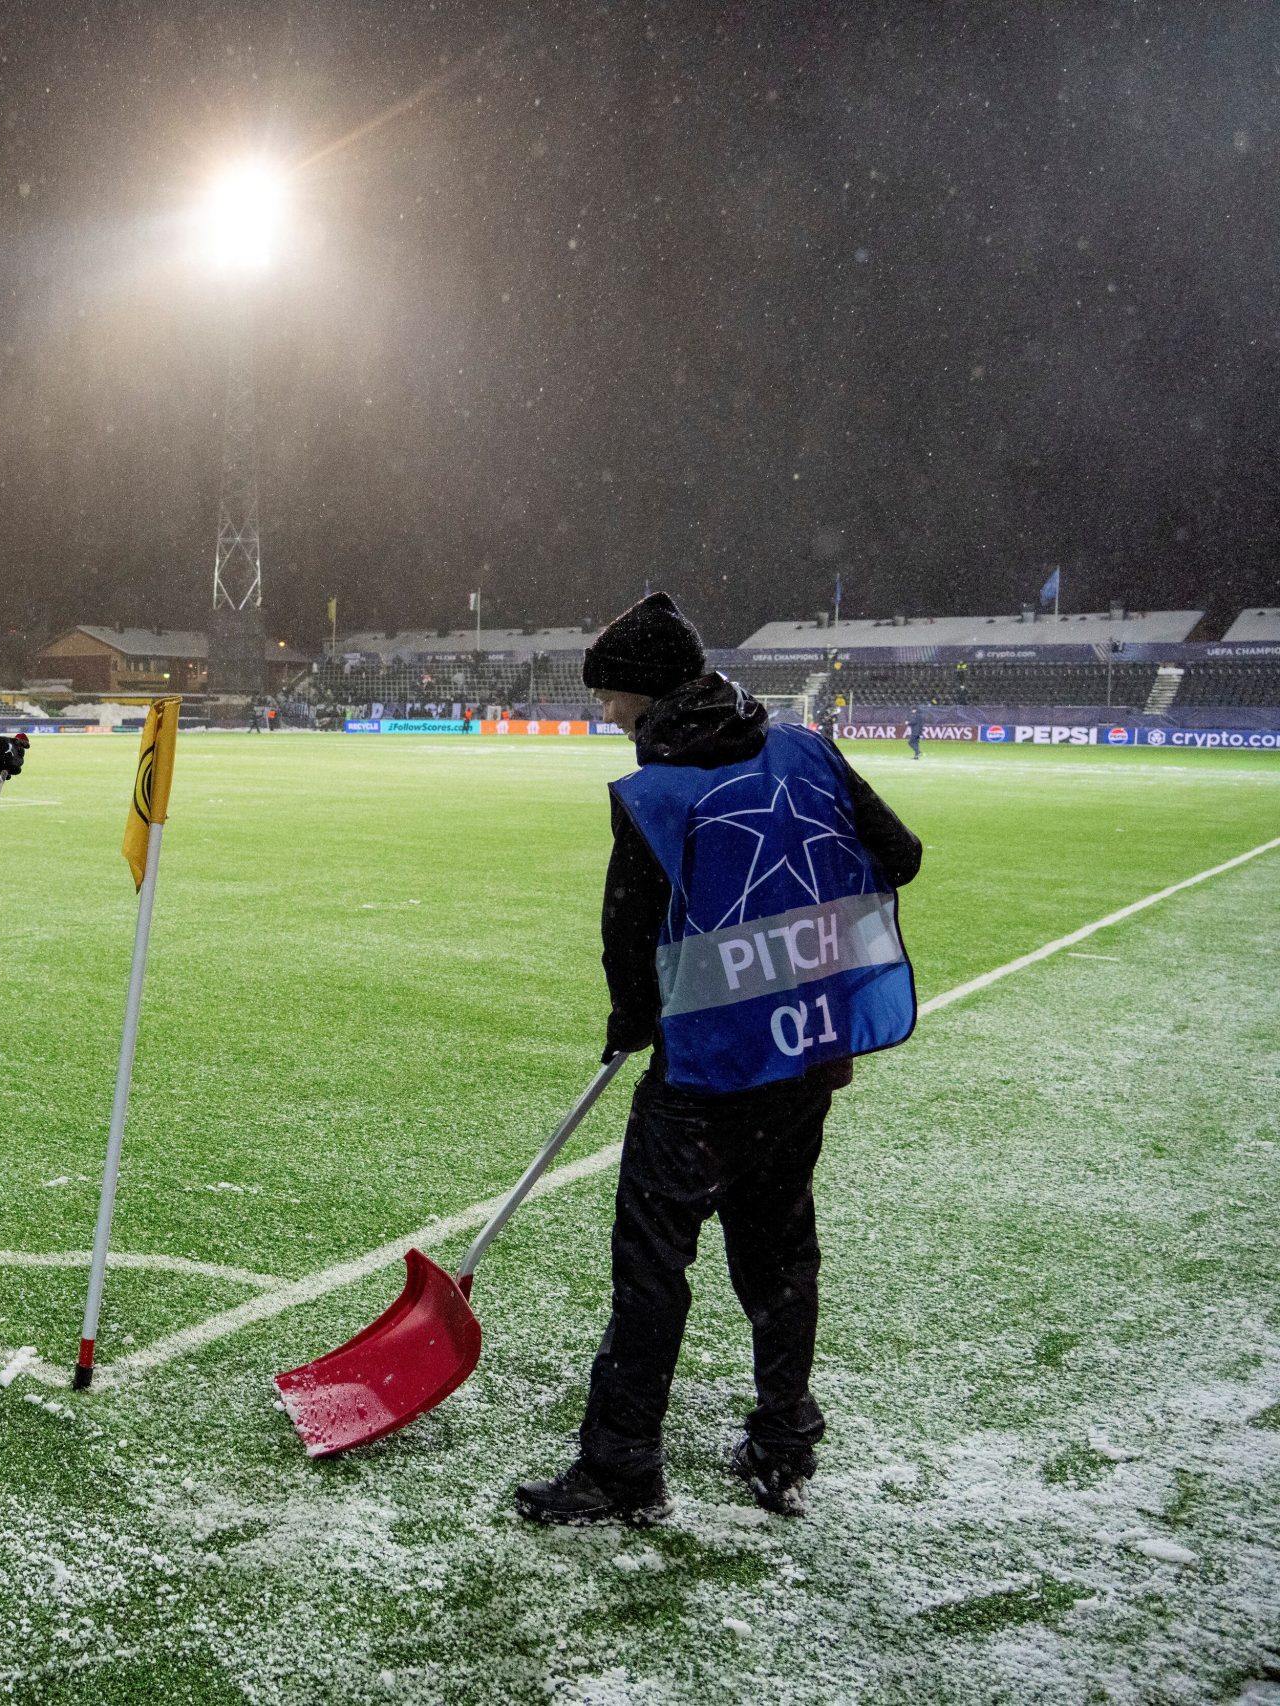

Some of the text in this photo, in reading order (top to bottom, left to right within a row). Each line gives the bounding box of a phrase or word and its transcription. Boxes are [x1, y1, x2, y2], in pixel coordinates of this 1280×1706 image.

[774, 653, 819, 661] CHAMPIONS
[987, 651, 1037, 659] crypto.com
[1206, 647, 1234, 656] UEFA
[348, 722, 379, 730] RECYCLE
[843, 725, 973, 740] QATAR ARWAYS
[1015, 725, 1098, 745] PEPSI
[1172, 731, 1280, 748] crypto.co
[718, 913, 839, 990] PITCH
